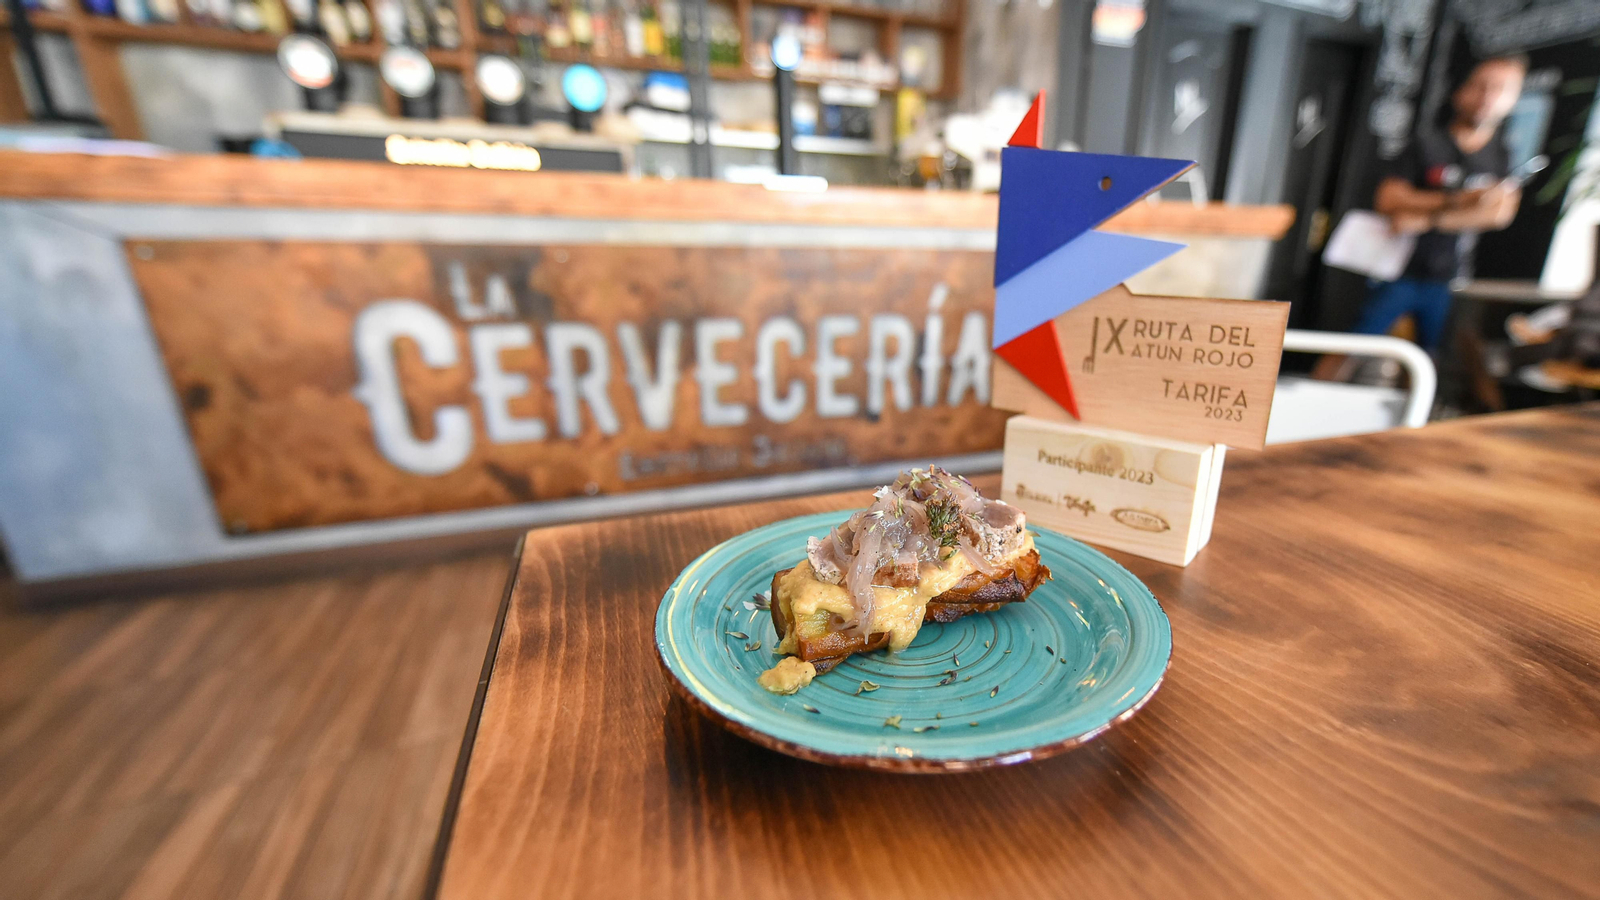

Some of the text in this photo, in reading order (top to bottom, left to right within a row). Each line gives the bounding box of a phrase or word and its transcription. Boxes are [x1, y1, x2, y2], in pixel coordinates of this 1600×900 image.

[449, 260, 517, 321] LA
[1133, 319, 1256, 348] RUTA DEL
[1131, 343, 1254, 369] ATUN ROJO
[354, 282, 993, 477] CERVECERÍA
[1162, 378, 1248, 409] TARIFA
[1204, 406, 1243, 422] 2023
[1037, 449, 1155, 485] Participante 2023
